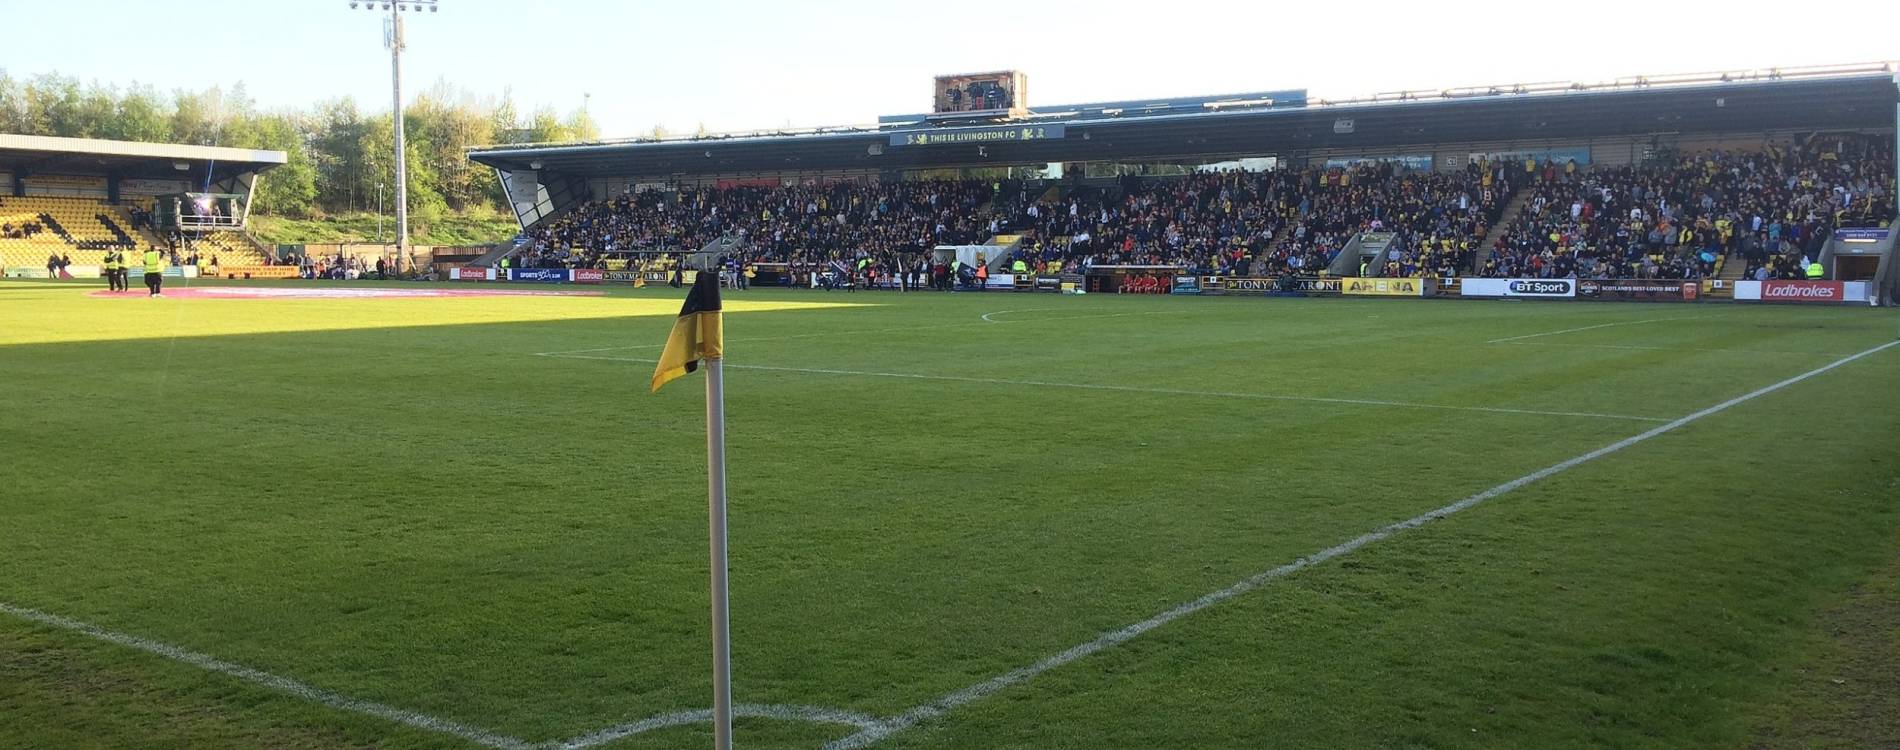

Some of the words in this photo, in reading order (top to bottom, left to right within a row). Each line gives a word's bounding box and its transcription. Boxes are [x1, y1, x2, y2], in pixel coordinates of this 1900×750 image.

[930, 134, 946, 143] THIS
[947, 134, 955, 142] IS
[957, 131, 1003, 141] LIVINGSTON
[1005, 131, 1016, 139] FC
[461, 269, 484, 278] Ladbrokes
[577, 271, 603, 280] Ladbrokes
[609, 271, 628, 280] TONY
[629, 271, 667, 280] MAARONI
[1237, 280, 1269, 289] TONY
[1272, 281, 1340, 290] MARONI
[1516, 282, 1533, 291] BT
[1534, 282, 1564, 292] Sport
[1765, 284, 1834, 297] Ladbrokes
